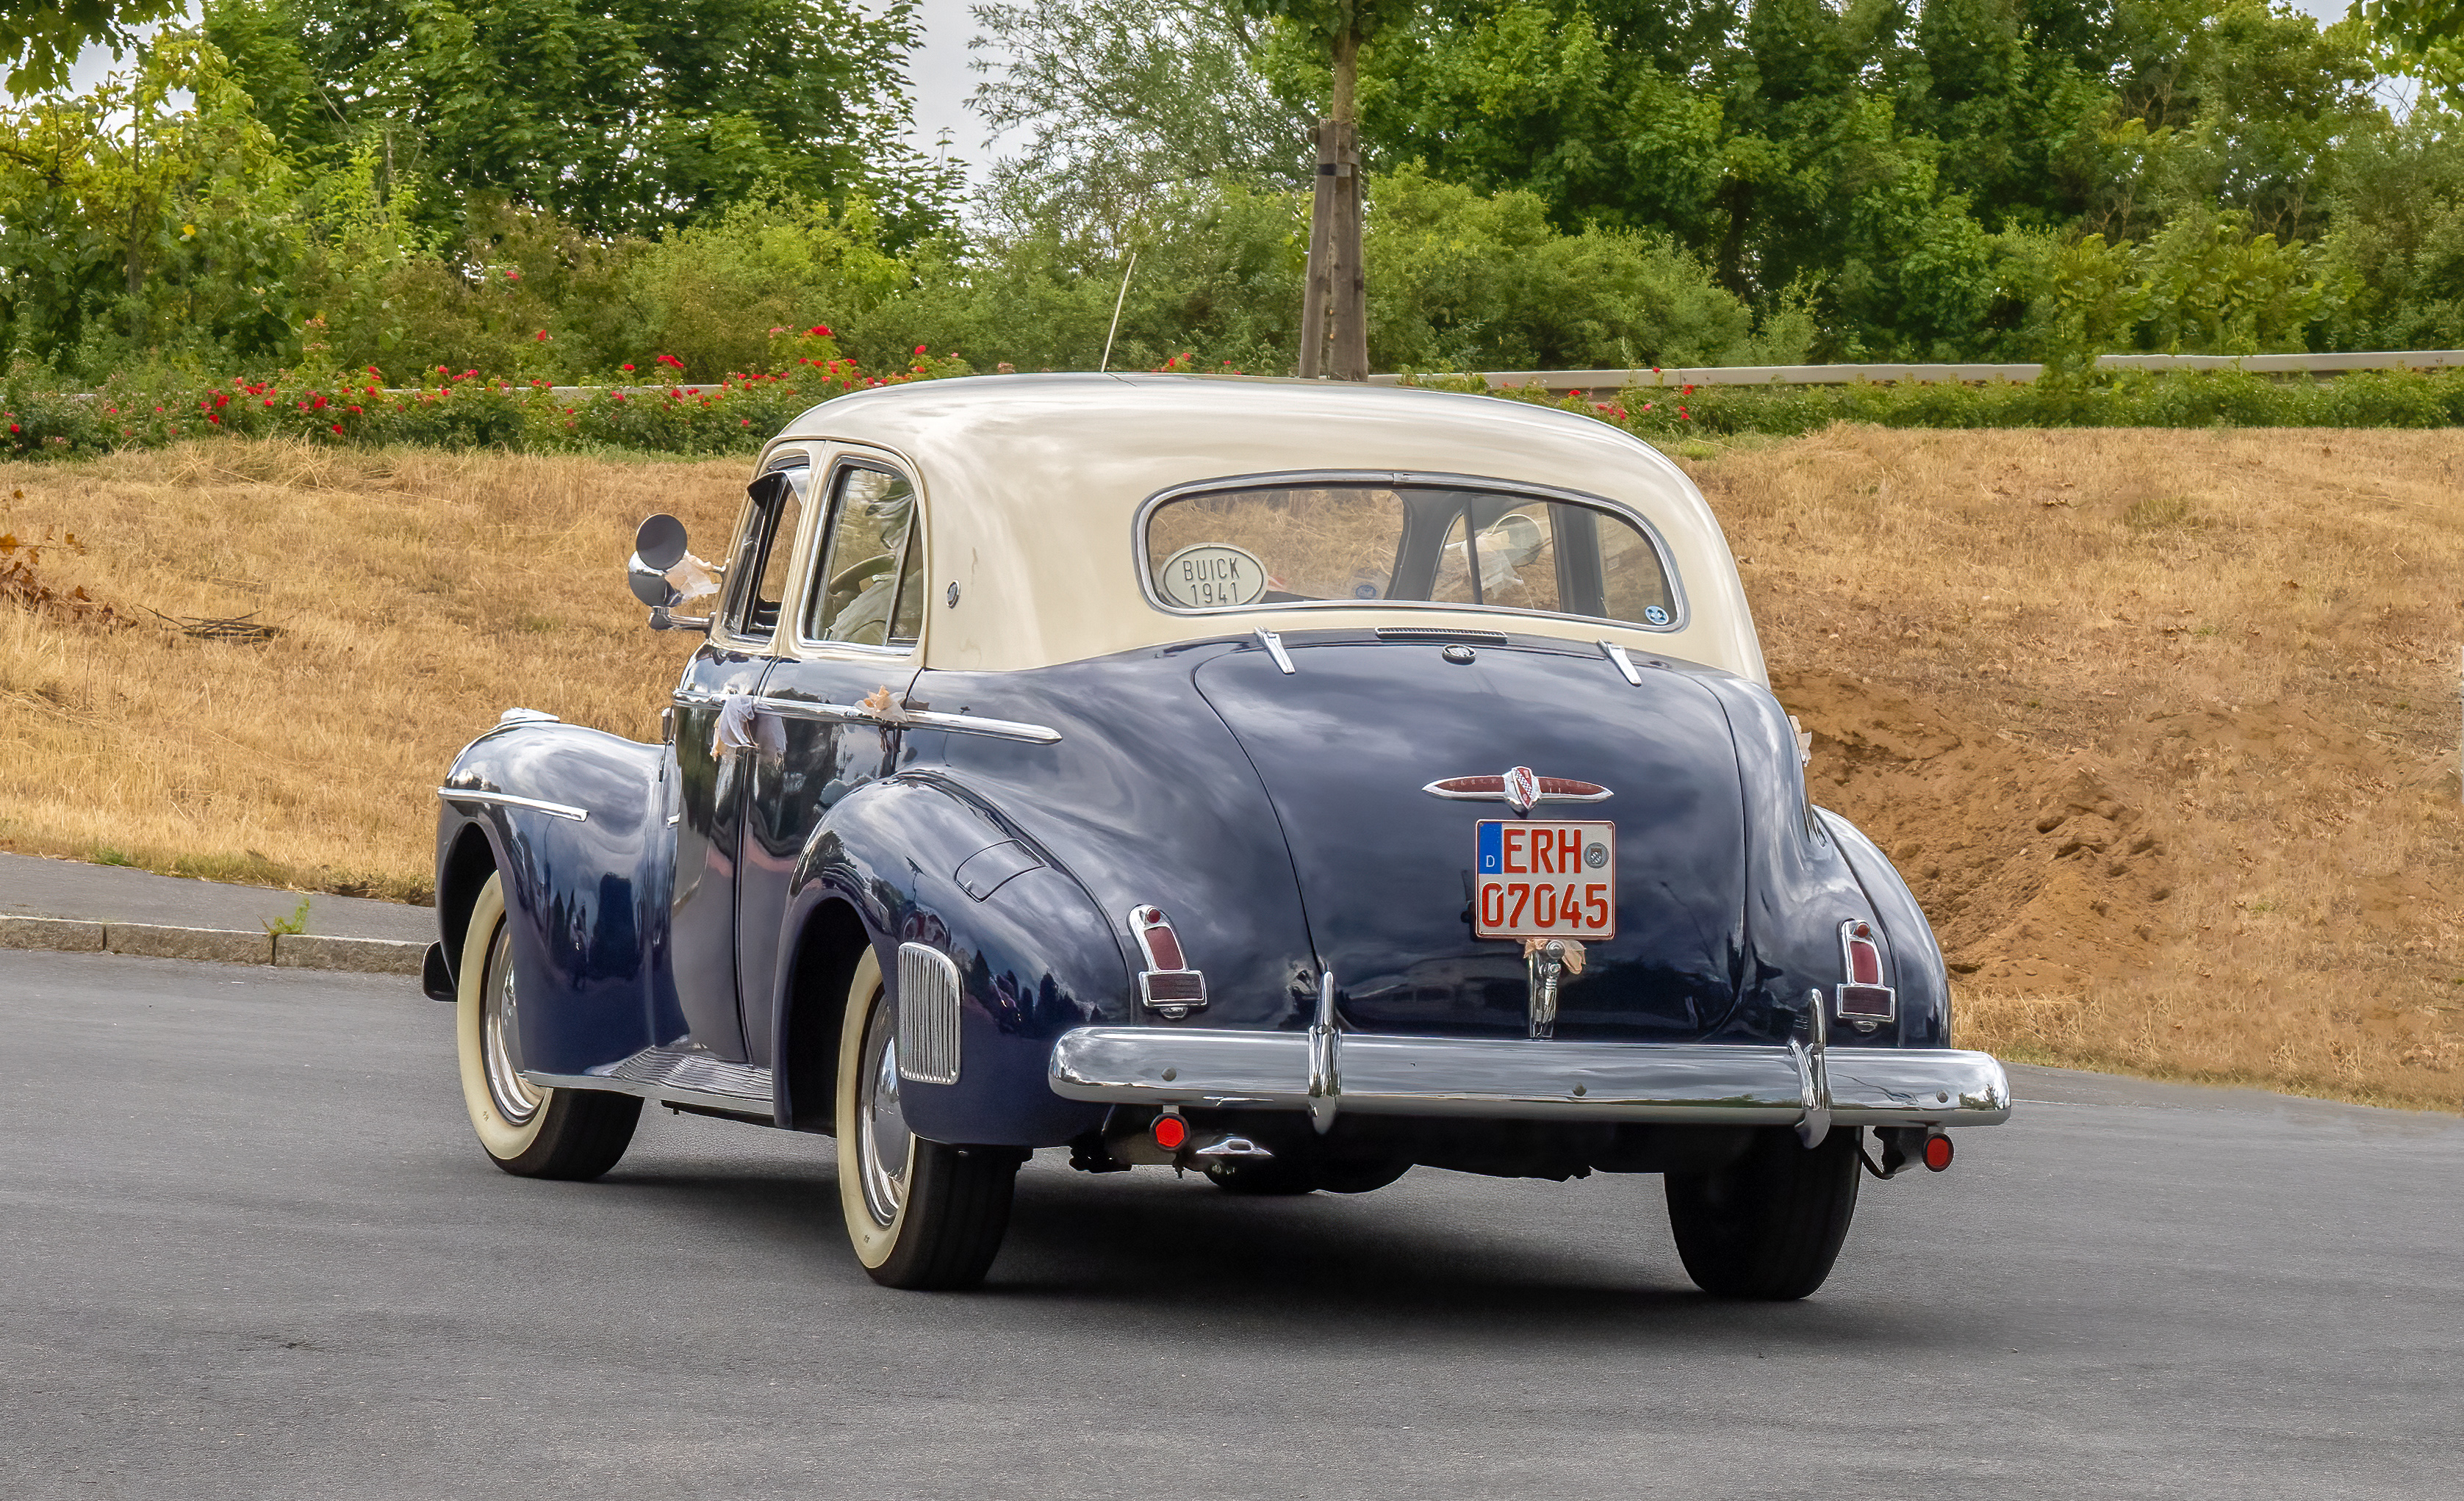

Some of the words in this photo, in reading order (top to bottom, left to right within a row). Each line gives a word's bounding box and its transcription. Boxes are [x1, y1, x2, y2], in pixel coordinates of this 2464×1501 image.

[1182, 558, 1240, 581] BUICK
[1190, 582, 1238, 605] 1941
[1485, 854, 1495, 868] D
[1504, 829, 1581, 874] ERH
[1481, 882, 1609, 929] 07045
